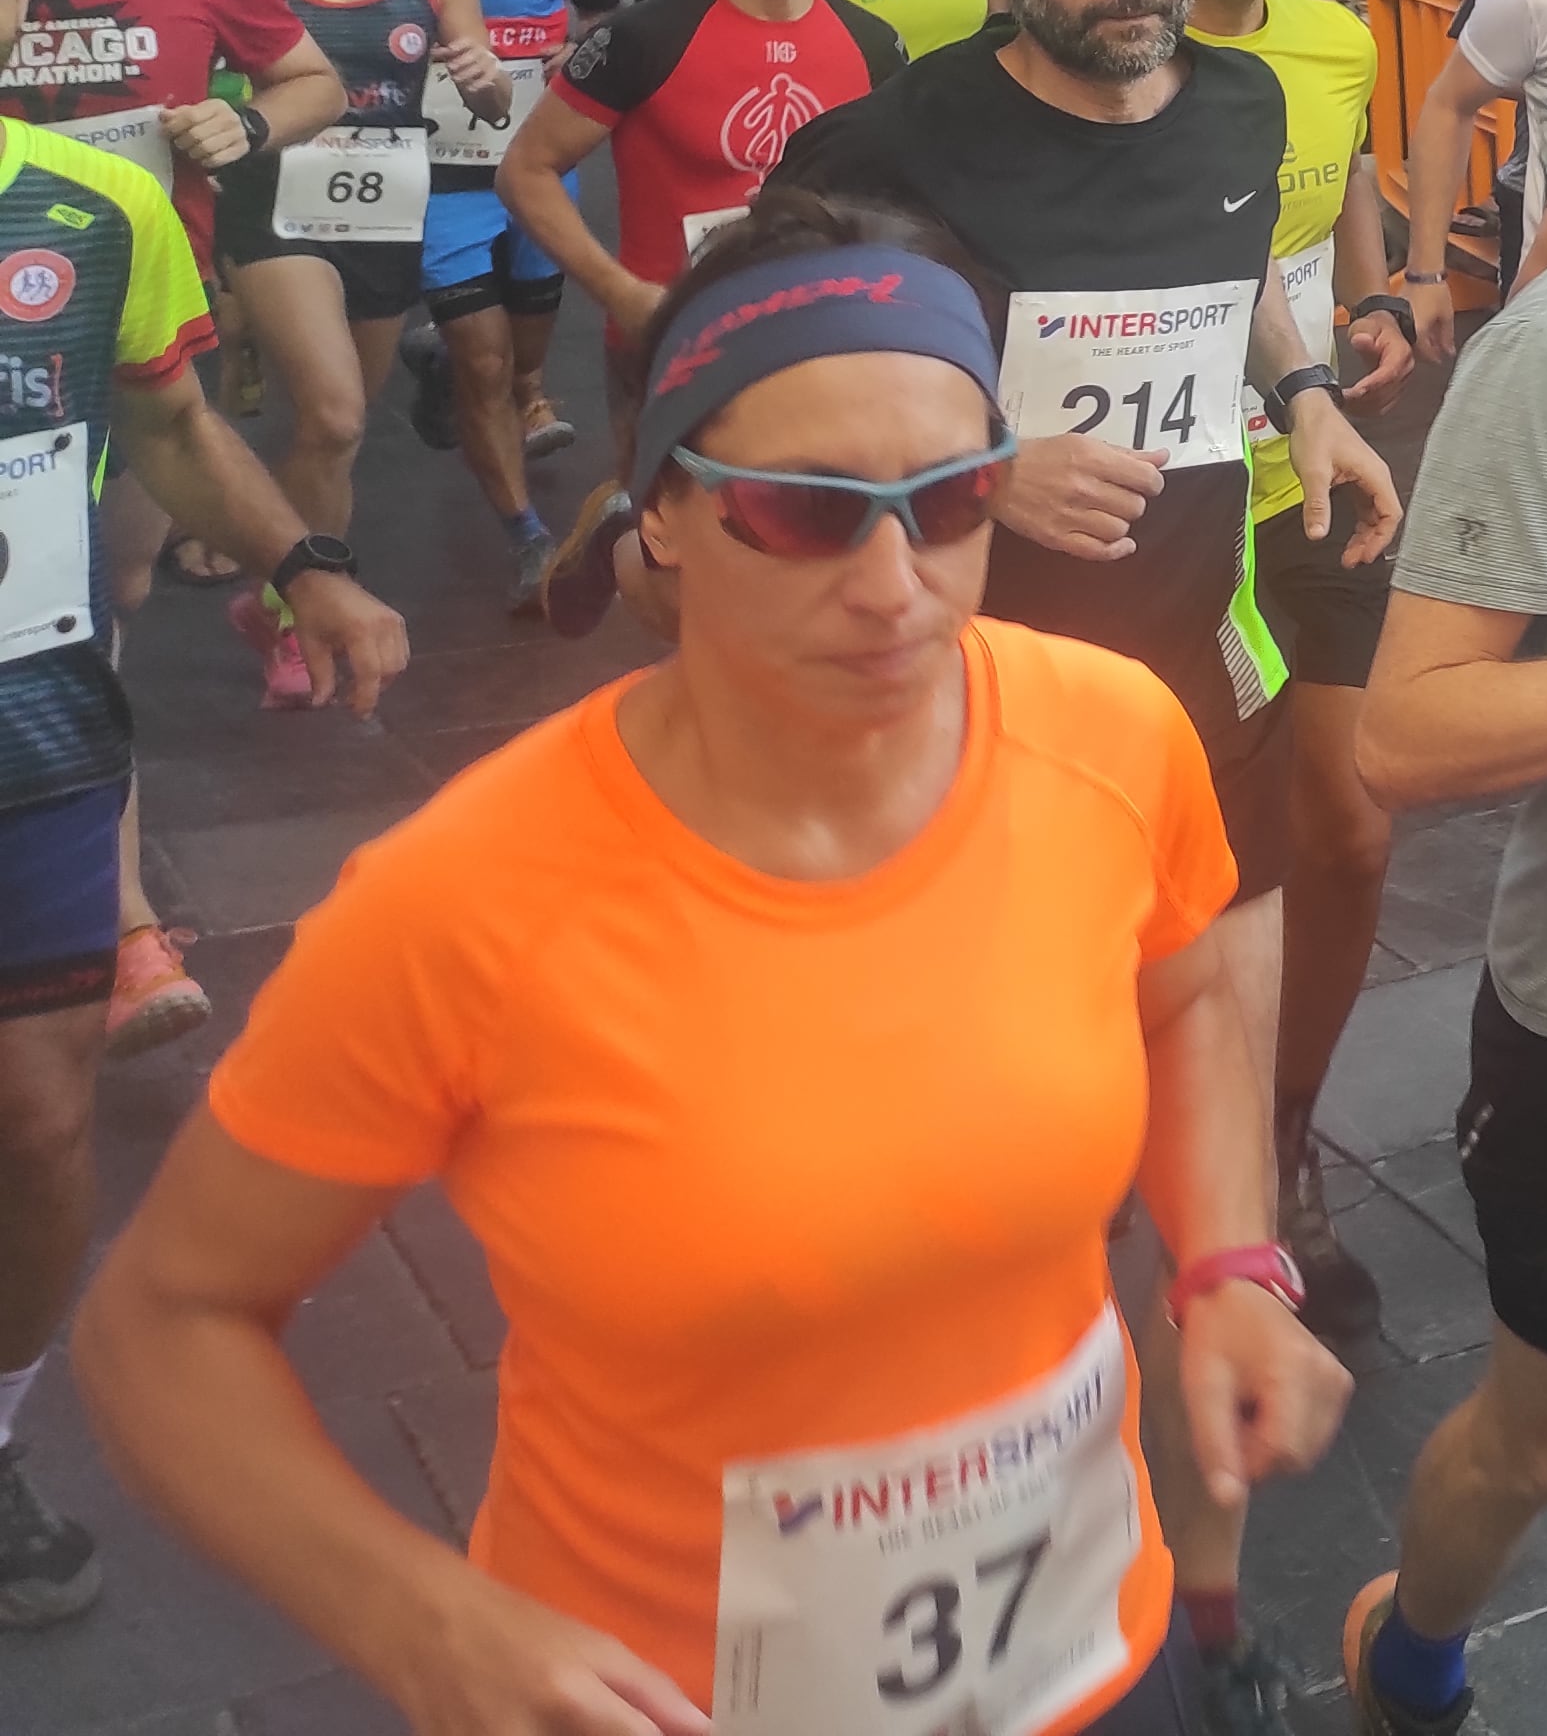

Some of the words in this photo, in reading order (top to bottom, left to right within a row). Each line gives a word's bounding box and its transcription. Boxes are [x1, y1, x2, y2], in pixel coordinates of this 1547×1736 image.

[9, 26, 158, 68] ICAGO
[0, 63, 122, 88] ARATHON
[74, 121, 152, 145] SPORT
[328, 171, 384, 204] 68
[1069, 302, 1238, 339] INTERSPORT
[1092, 347, 1112, 358] THE
[1117, 345, 1151, 357] HEART
[1153, 344, 1167, 354] OF
[1168, 339, 1196, 353] SPORT
[1061, 373, 1197, 452] 214
[877, 1528, 1053, 1706] 37
